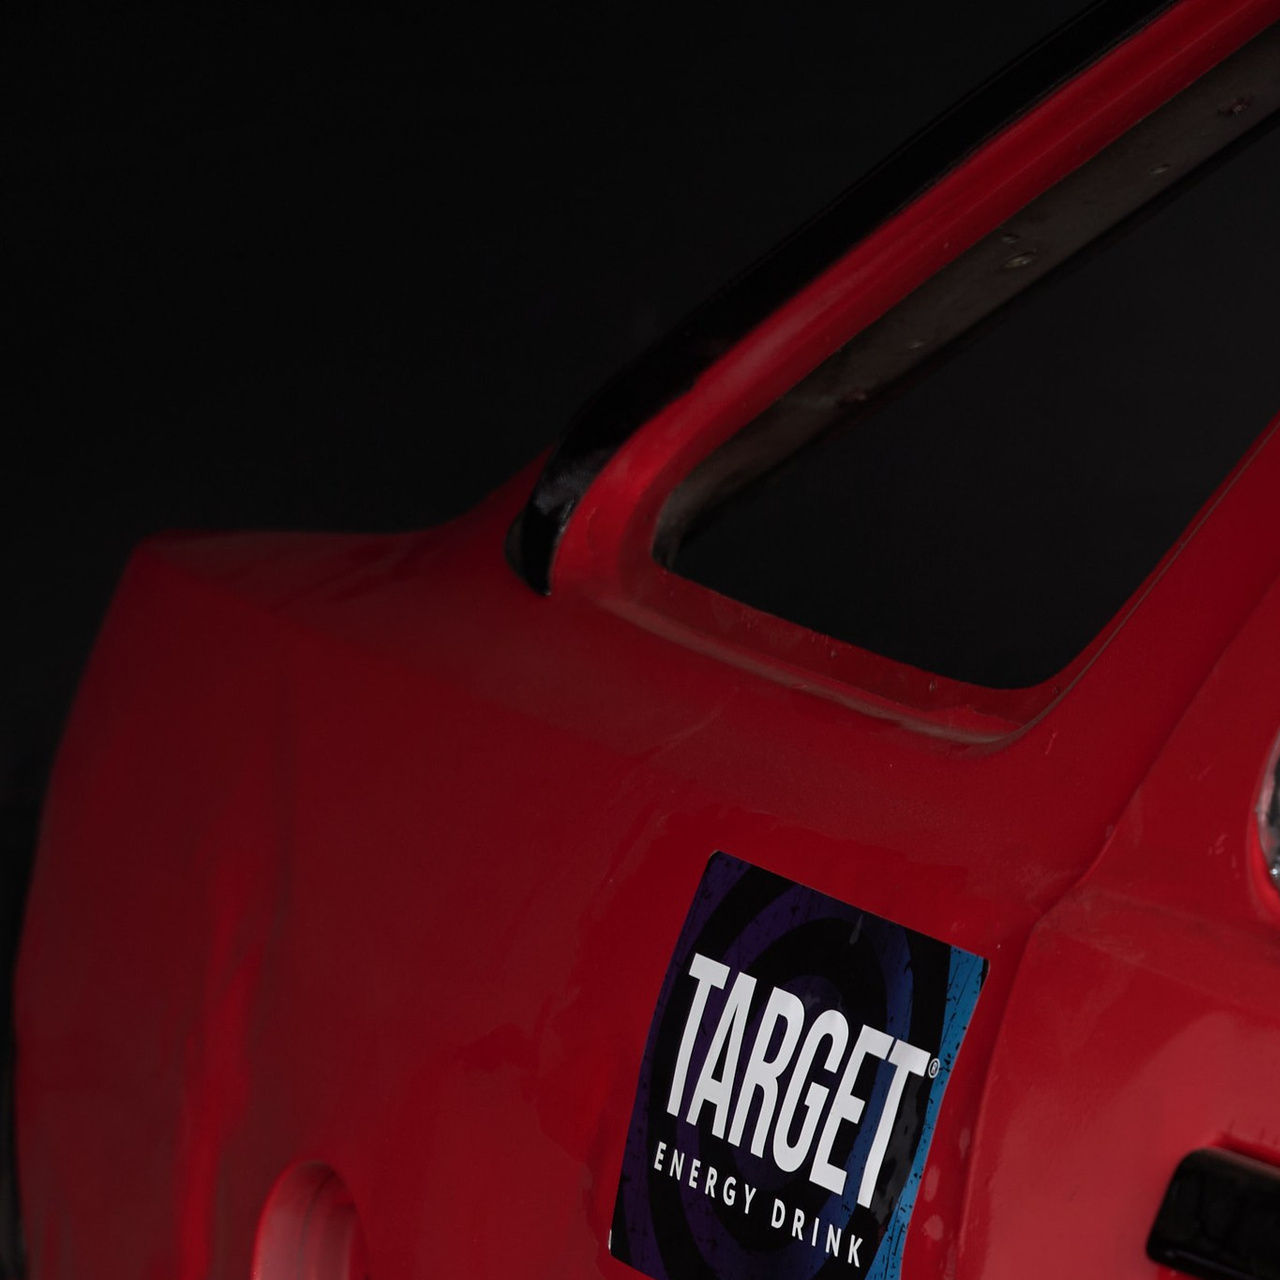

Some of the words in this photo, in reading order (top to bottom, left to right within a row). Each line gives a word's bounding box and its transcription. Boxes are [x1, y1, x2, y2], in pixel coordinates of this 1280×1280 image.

[666, 952, 931, 1209] TARGET
[653, 1141, 757, 1215] ENERGY
[770, 1197, 864, 1268] DRINK
